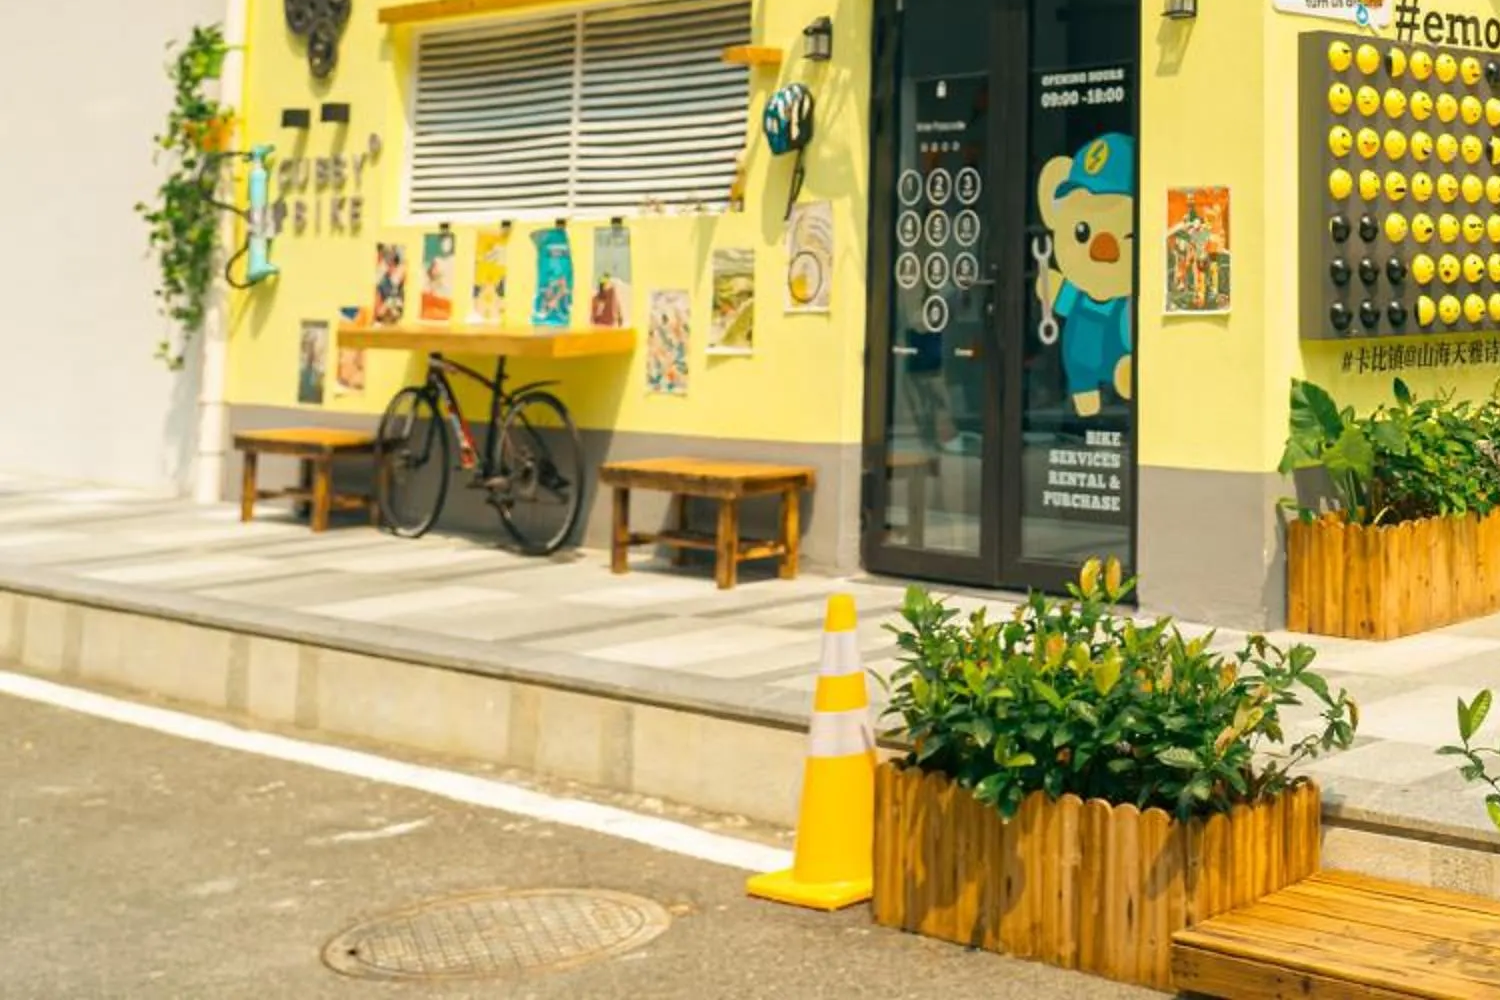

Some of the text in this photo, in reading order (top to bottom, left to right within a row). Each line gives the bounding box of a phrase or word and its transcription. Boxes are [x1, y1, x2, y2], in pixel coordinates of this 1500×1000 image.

[1049, 449, 1121, 468] SERVICES
[1048, 470, 1121, 490] RENTAL &
[1043, 490, 1121, 511] PURCHASE
